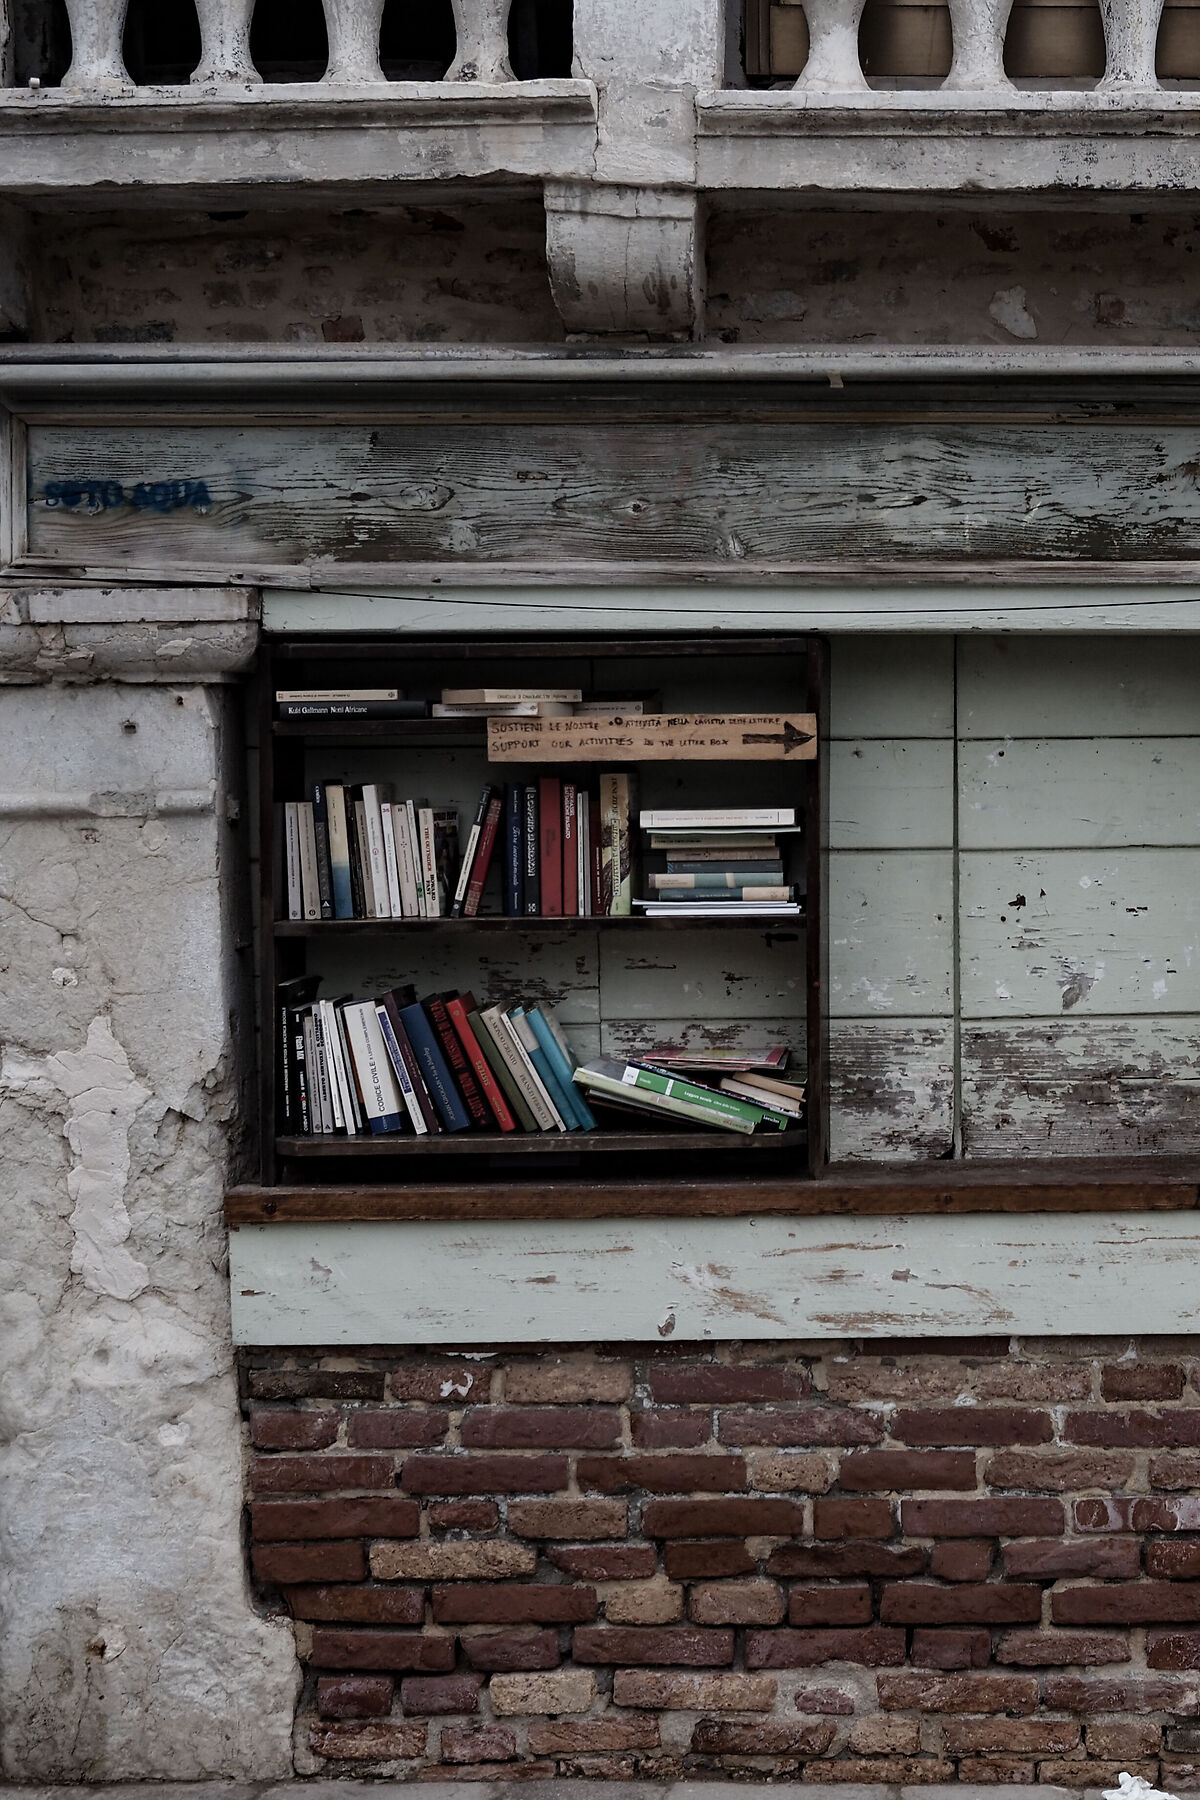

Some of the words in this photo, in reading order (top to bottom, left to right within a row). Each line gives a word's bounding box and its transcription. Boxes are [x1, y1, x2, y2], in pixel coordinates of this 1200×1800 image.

[491, 721, 543, 734] SOSTIENI
[549, 722, 562, 732] LE
[565, 721, 600, 732] NOSTRE
[667, 718, 690, 727] NELLA
[492, 740, 540, 752] SUPPORT
[552, 740, 573, 749] OUR
[579, 737, 634, 746] ACTIVITIES
[710, 738, 730, 746] BOX
[370, 1062, 380, 1084] CIVILE
[475, 1060, 491, 1086] SISTERS
[374, 1084, 386, 1112] CODICE
